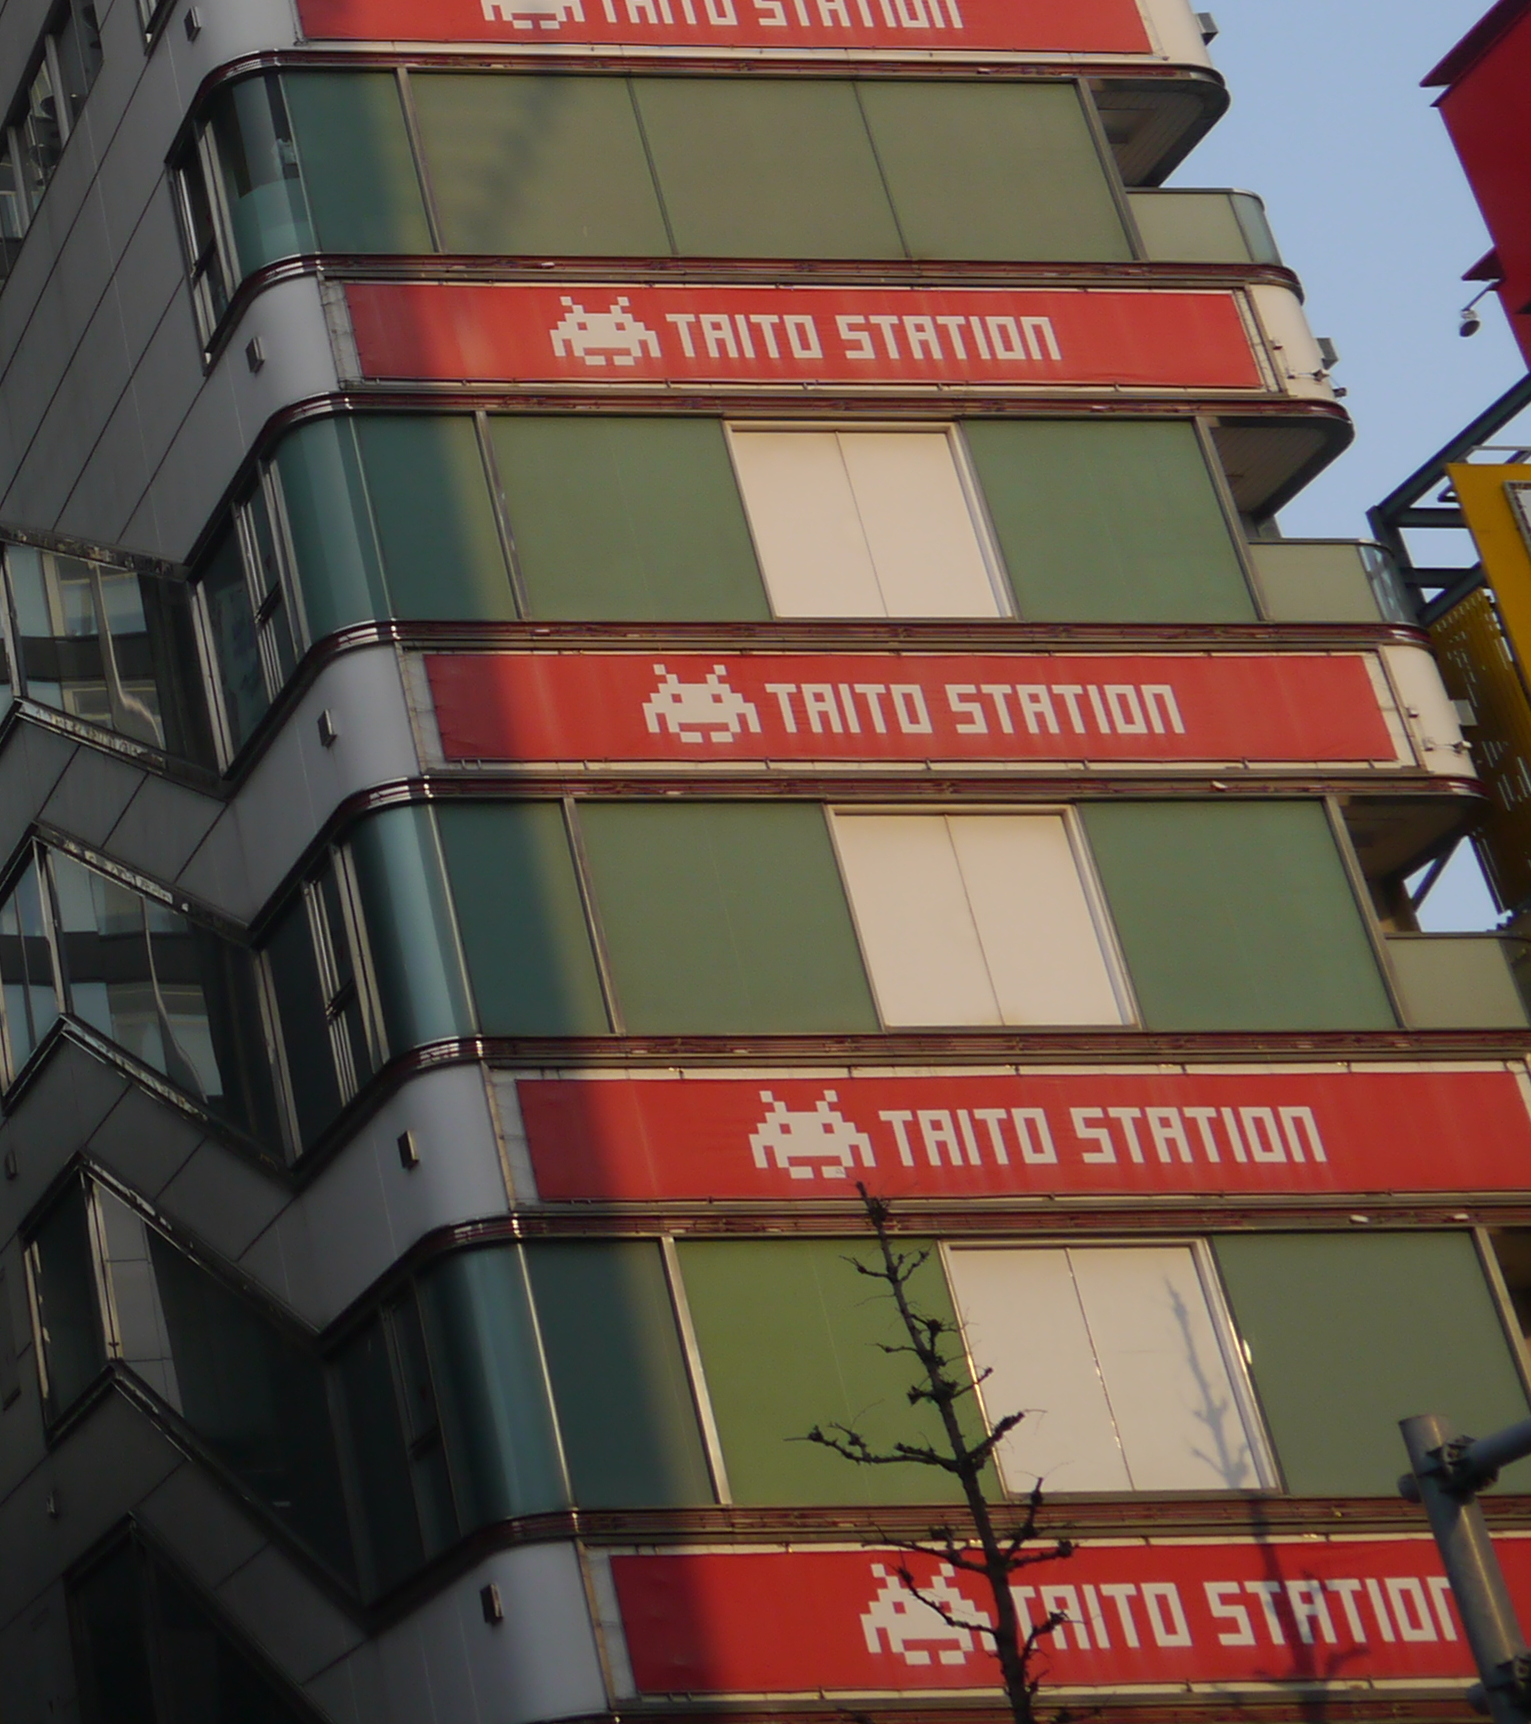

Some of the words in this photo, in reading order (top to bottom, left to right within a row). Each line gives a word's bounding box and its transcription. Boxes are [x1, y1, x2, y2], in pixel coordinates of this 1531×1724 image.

[665, 313, 822, 360] TAITO
[836, 315, 1062, 362] STATION
[765, 682, 934, 734] TAITO
[945, 682, 1186, 735] STATION
[878, 1107, 1059, 1166] TAITO
[1071, 1106, 1328, 1164] STATION
[1008, 1581, 1193, 1653] TAITO
